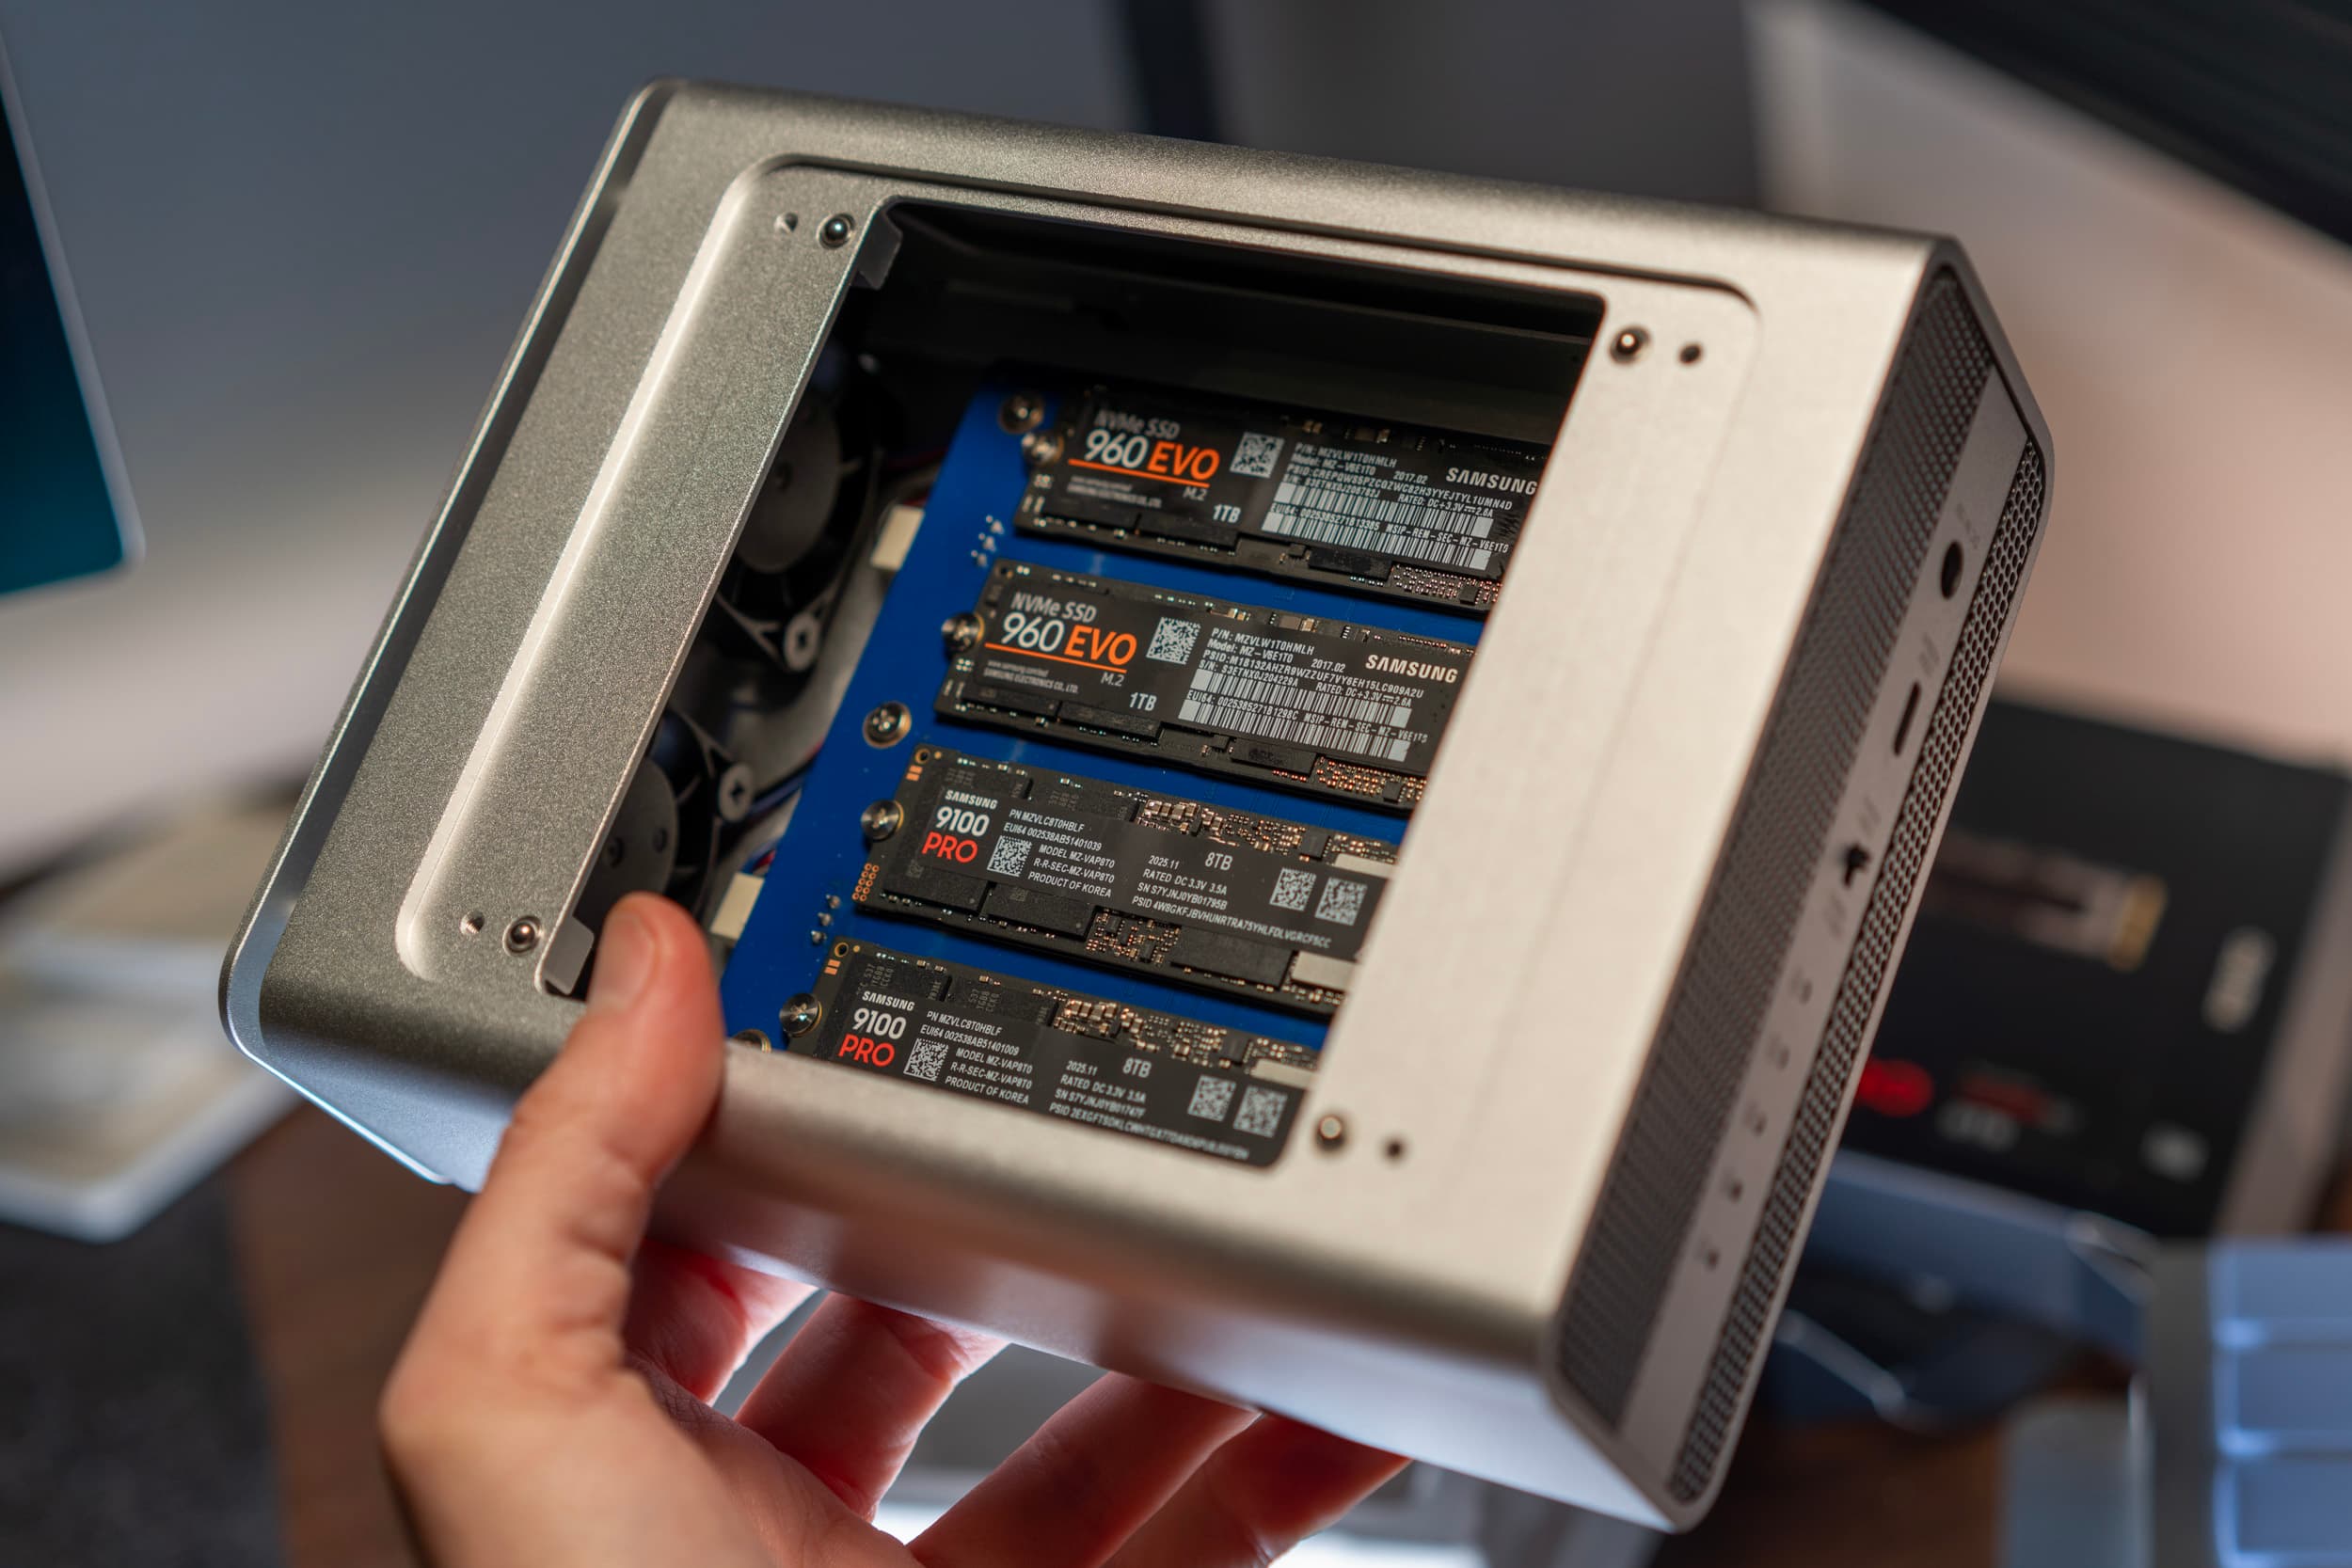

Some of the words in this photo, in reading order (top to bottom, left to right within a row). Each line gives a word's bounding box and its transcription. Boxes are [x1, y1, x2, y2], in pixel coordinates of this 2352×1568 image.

[1095, 409, 1144, 434] NVMe
[1144, 419, 1180, 438] SSD
[1084, 429, 1149, 468] 960
[1147, 440, 1220, 481] EVO
[1393, 470, 1429, 485] 2017.02
[1445, 467, 1537, 495] SAMSUNG
[1183, 486, 1208, 500] M.2
[1398, 494, 1425, 509] RATED:
[1214, 503, 1241, 523] 1TB
[1010, 592, 1059, 617] NVMe
[1059, 601, 1097, 623] SSD
[1001, 611, 1065, 653] 960
[1064, 624, 1137, 666] EVO
[1212, 627, 1232, 641] P/N:
[1207, 639, 1237, 654] Model:
[1311, 658, 1345, 673] 2017.02
[1199, 661, 1217, 673] S/N:
[1315, 682, 1343, 696] RATED:
[1366, 655, 1458, 683] SAMSUNG
[1013, 673, 1054, 689] ELECTRONICS
[1101, 672, 1124, 687] M.2
[1130, 691, 1157, 711] 1TB
[1187, 690, 1215, 705] EUI64:
[945, 790, 997, 810] SAMSUNG
[936, 806, 990, 836] 9100
[1009, 809, 1022, 819] PN
[1004, 823, 1026, 835] EUI64
[921, 832, 977, 863] PRO
[1039, 845, 1068, 860] MODEL
[1148, 855, 1179, 870] 2025.11
[1205, 852, 1233, 871] 8TB
[1028, 872, 1069, 888] PRODUCT
[1069, 879, 1082, 890] OF
[1082, 882, 1112, 898] KOREA
[1137, 882, 1151, 894] SN
[1143, 868, 1172, 882] RATED
[1174, 876, 1188, 887] DC
[1188, 879, 1207, 891] 3.3V
[1209, 883, 1227, 895] 3.5A
[1132, 895, 1152, 909] PSID
[862, 990, 914, 1011] SAMSUNG
[852, 1008, 907, 1039] 9100
[927, 1011, 938, 1022] PN
[920, 1024, 943, 1037] EUI64
[837, 1034, 895, 1067] PRO
[956, 1048, 985, 1063] MODEL
[1066, 1060, 1098, 1075] 2025.11
[1122, 1057, 1152, 1078] 8TB
[946, 1076, 985, 1093] PRODUCT
[986, 1085, 999, 1096] OF
[999, 1089, 1029, 1105] KOREA
[1060, 1074, 1090, 1090] RATED
[1092, 1082, 1106, 1094] DC
[1055, 1089, 1068, 1100] SN
[1049, 1102, 1070, 1116] PSID
